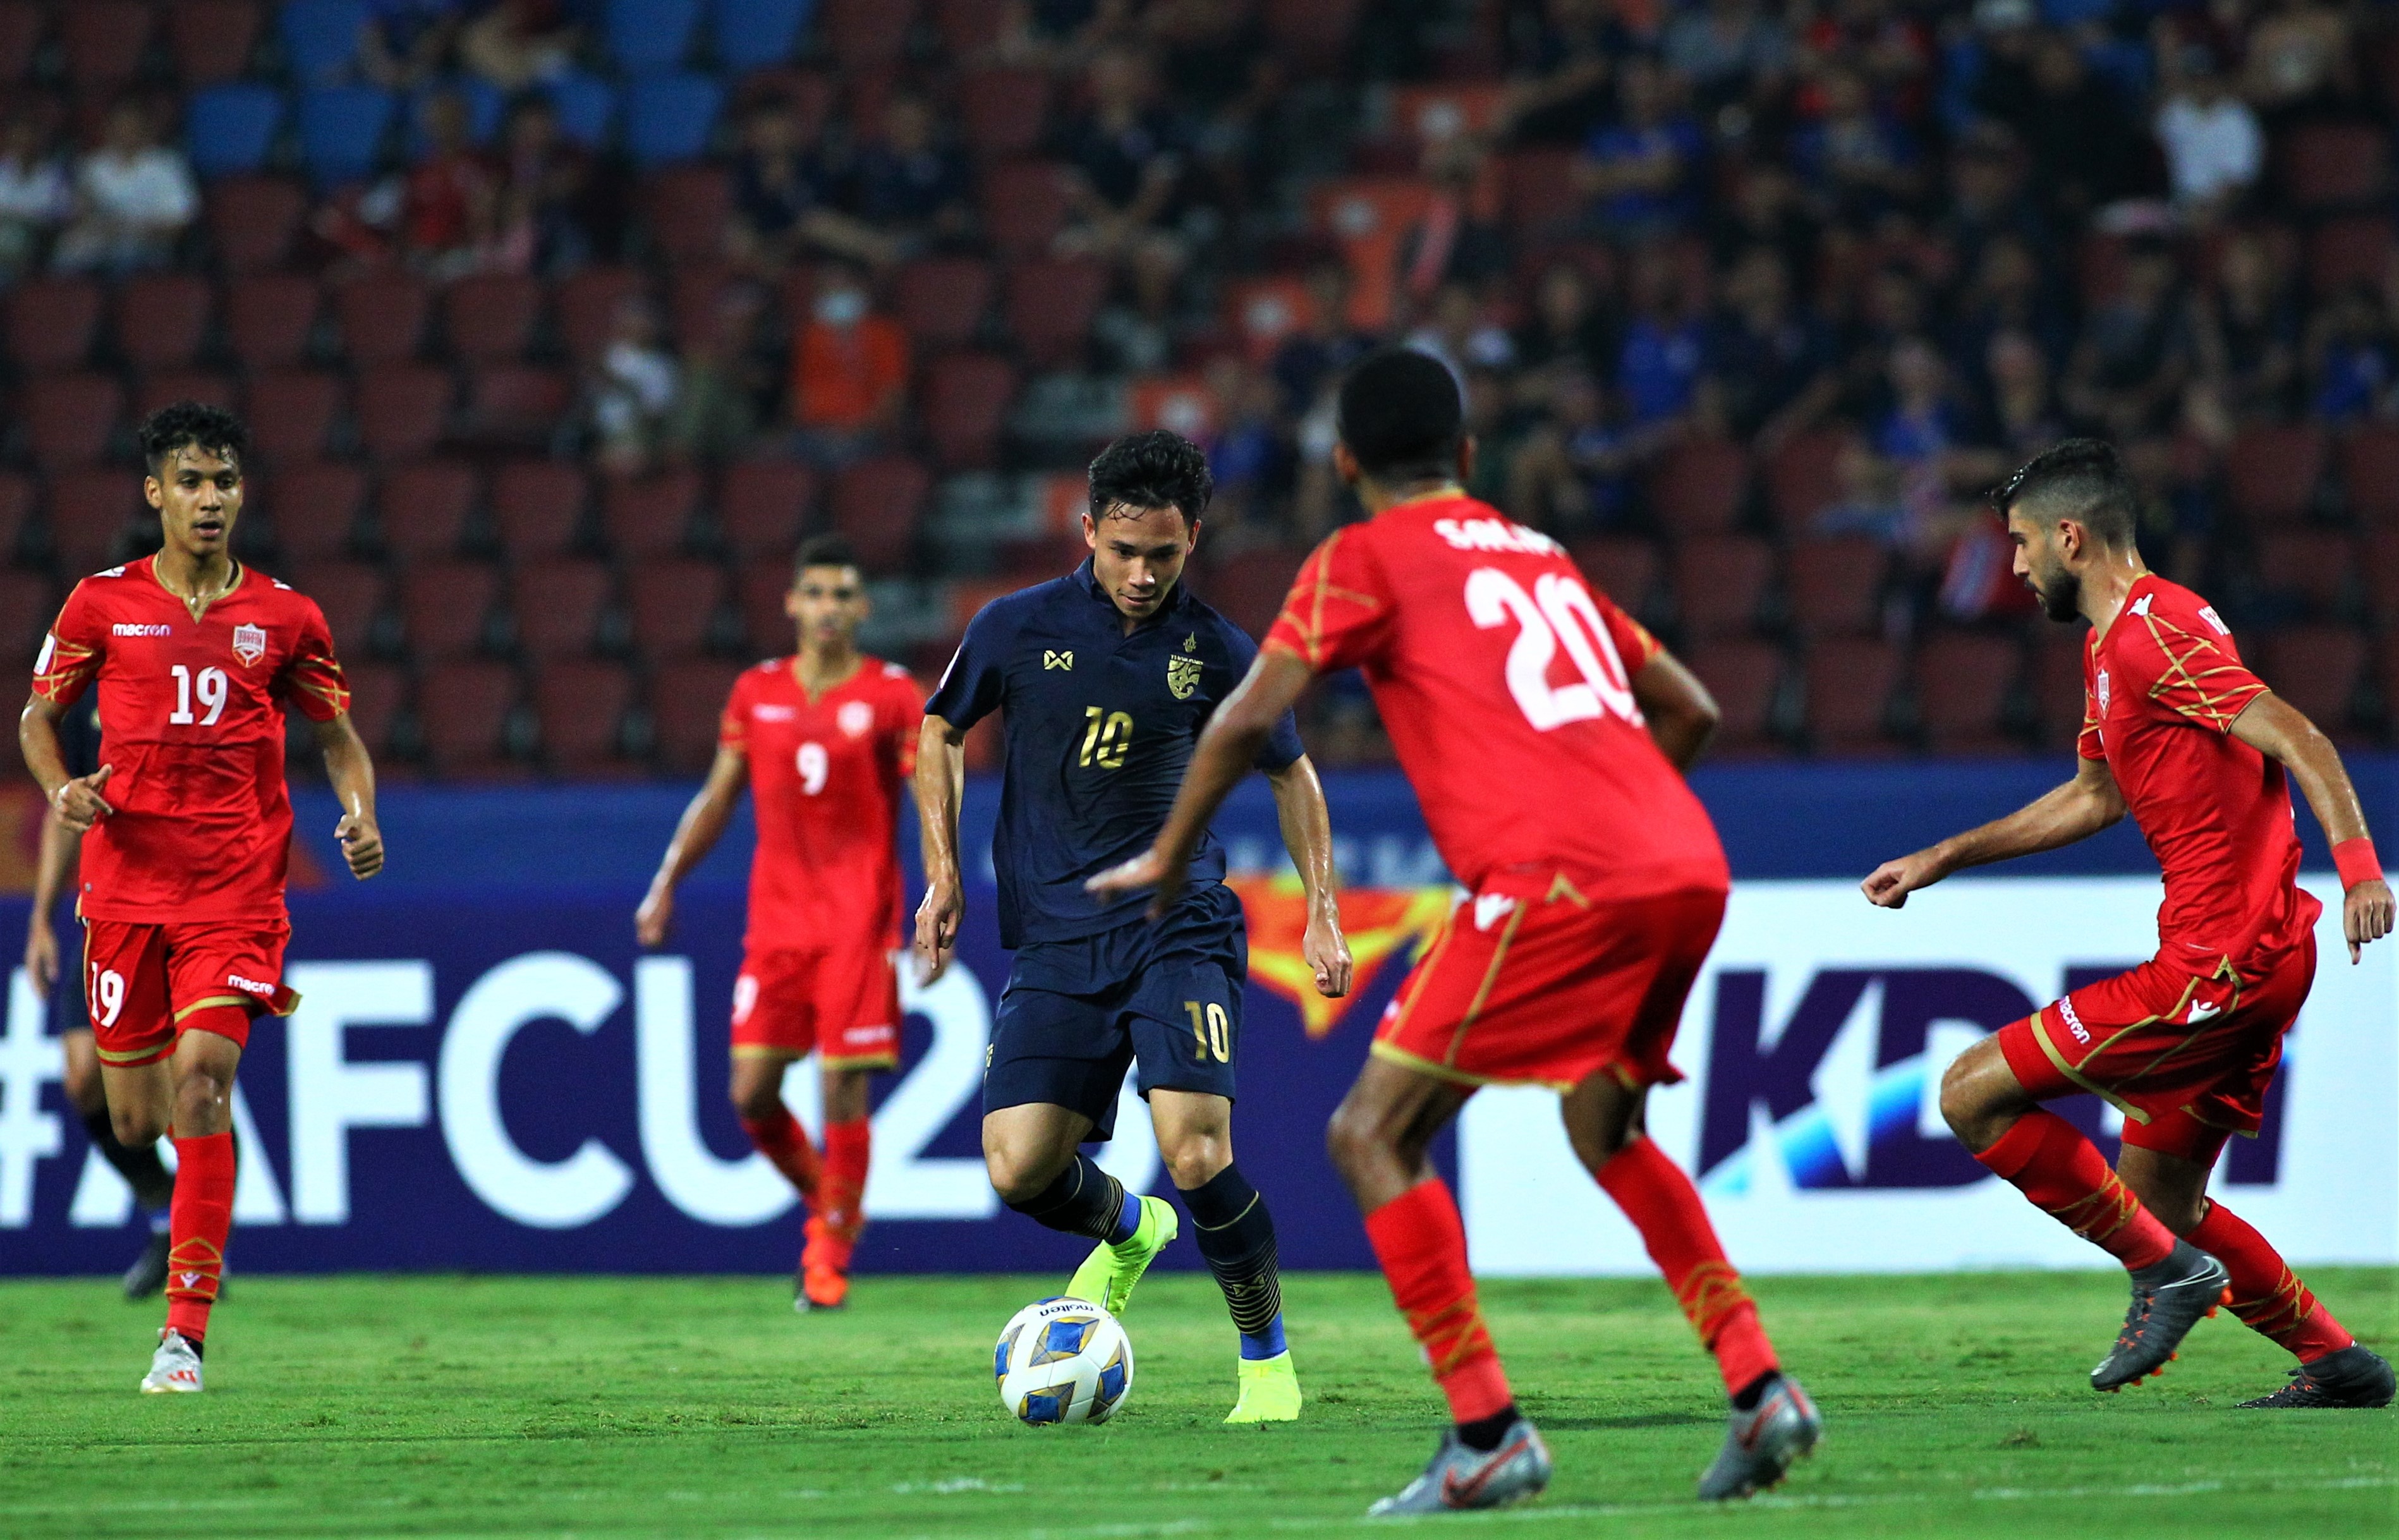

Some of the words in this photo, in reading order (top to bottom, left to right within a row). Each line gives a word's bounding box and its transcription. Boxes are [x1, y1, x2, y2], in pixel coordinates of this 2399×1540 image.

[113, 623, 171, 637] macron
[1463, 567, 1636, 732] 20
[170, 665, 228, 725] 19
[1079, 705, 1134, 769] 10
[796, 742, 829, 796] 9
[91, 961, 125, 1028] 19
[1184, 1001, 1229, 1064] 10
[1039, 1304, 1094, 1317] molten
